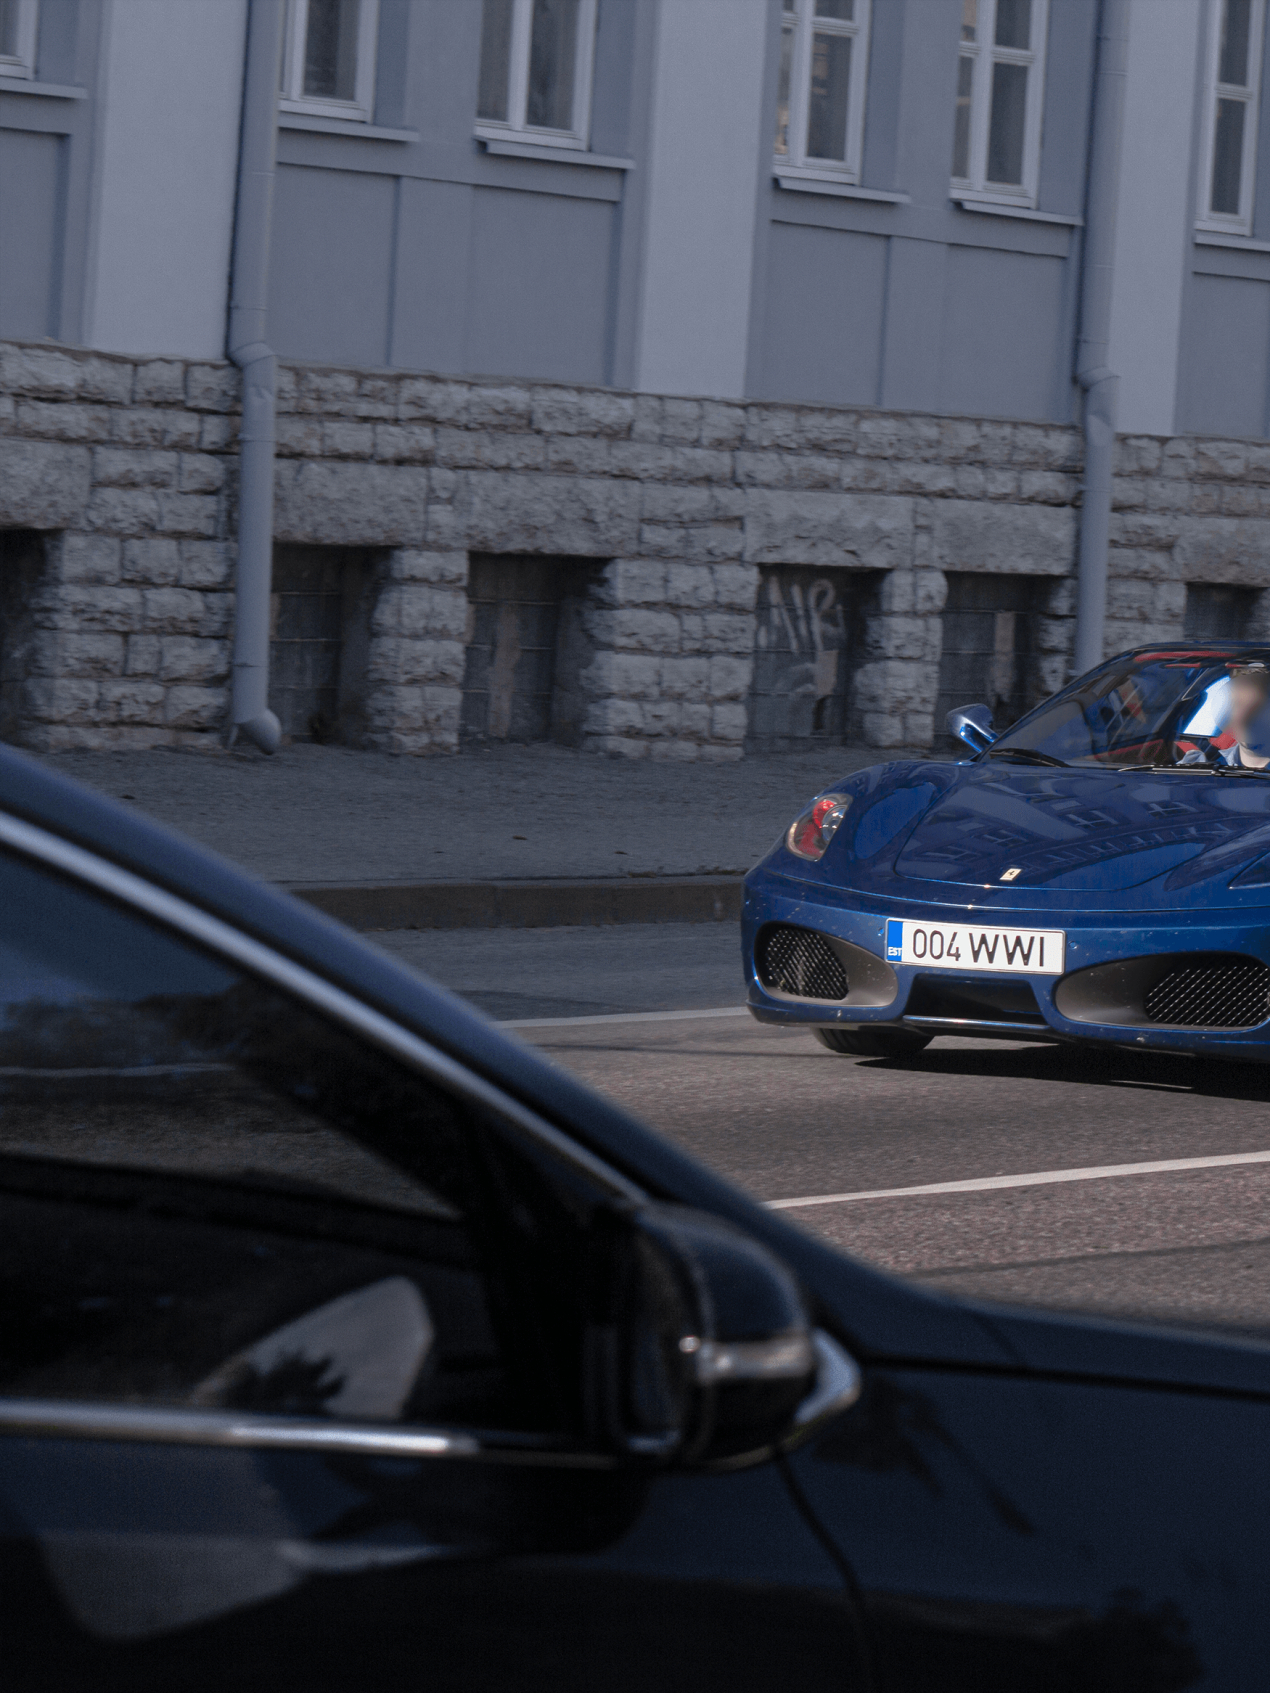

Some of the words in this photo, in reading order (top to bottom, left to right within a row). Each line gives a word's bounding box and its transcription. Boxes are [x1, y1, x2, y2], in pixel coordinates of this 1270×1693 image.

[887, 946, 903, 957] EST
[912, 928, 962, 962] 004
[968, 932, 1045, 967] WWI
